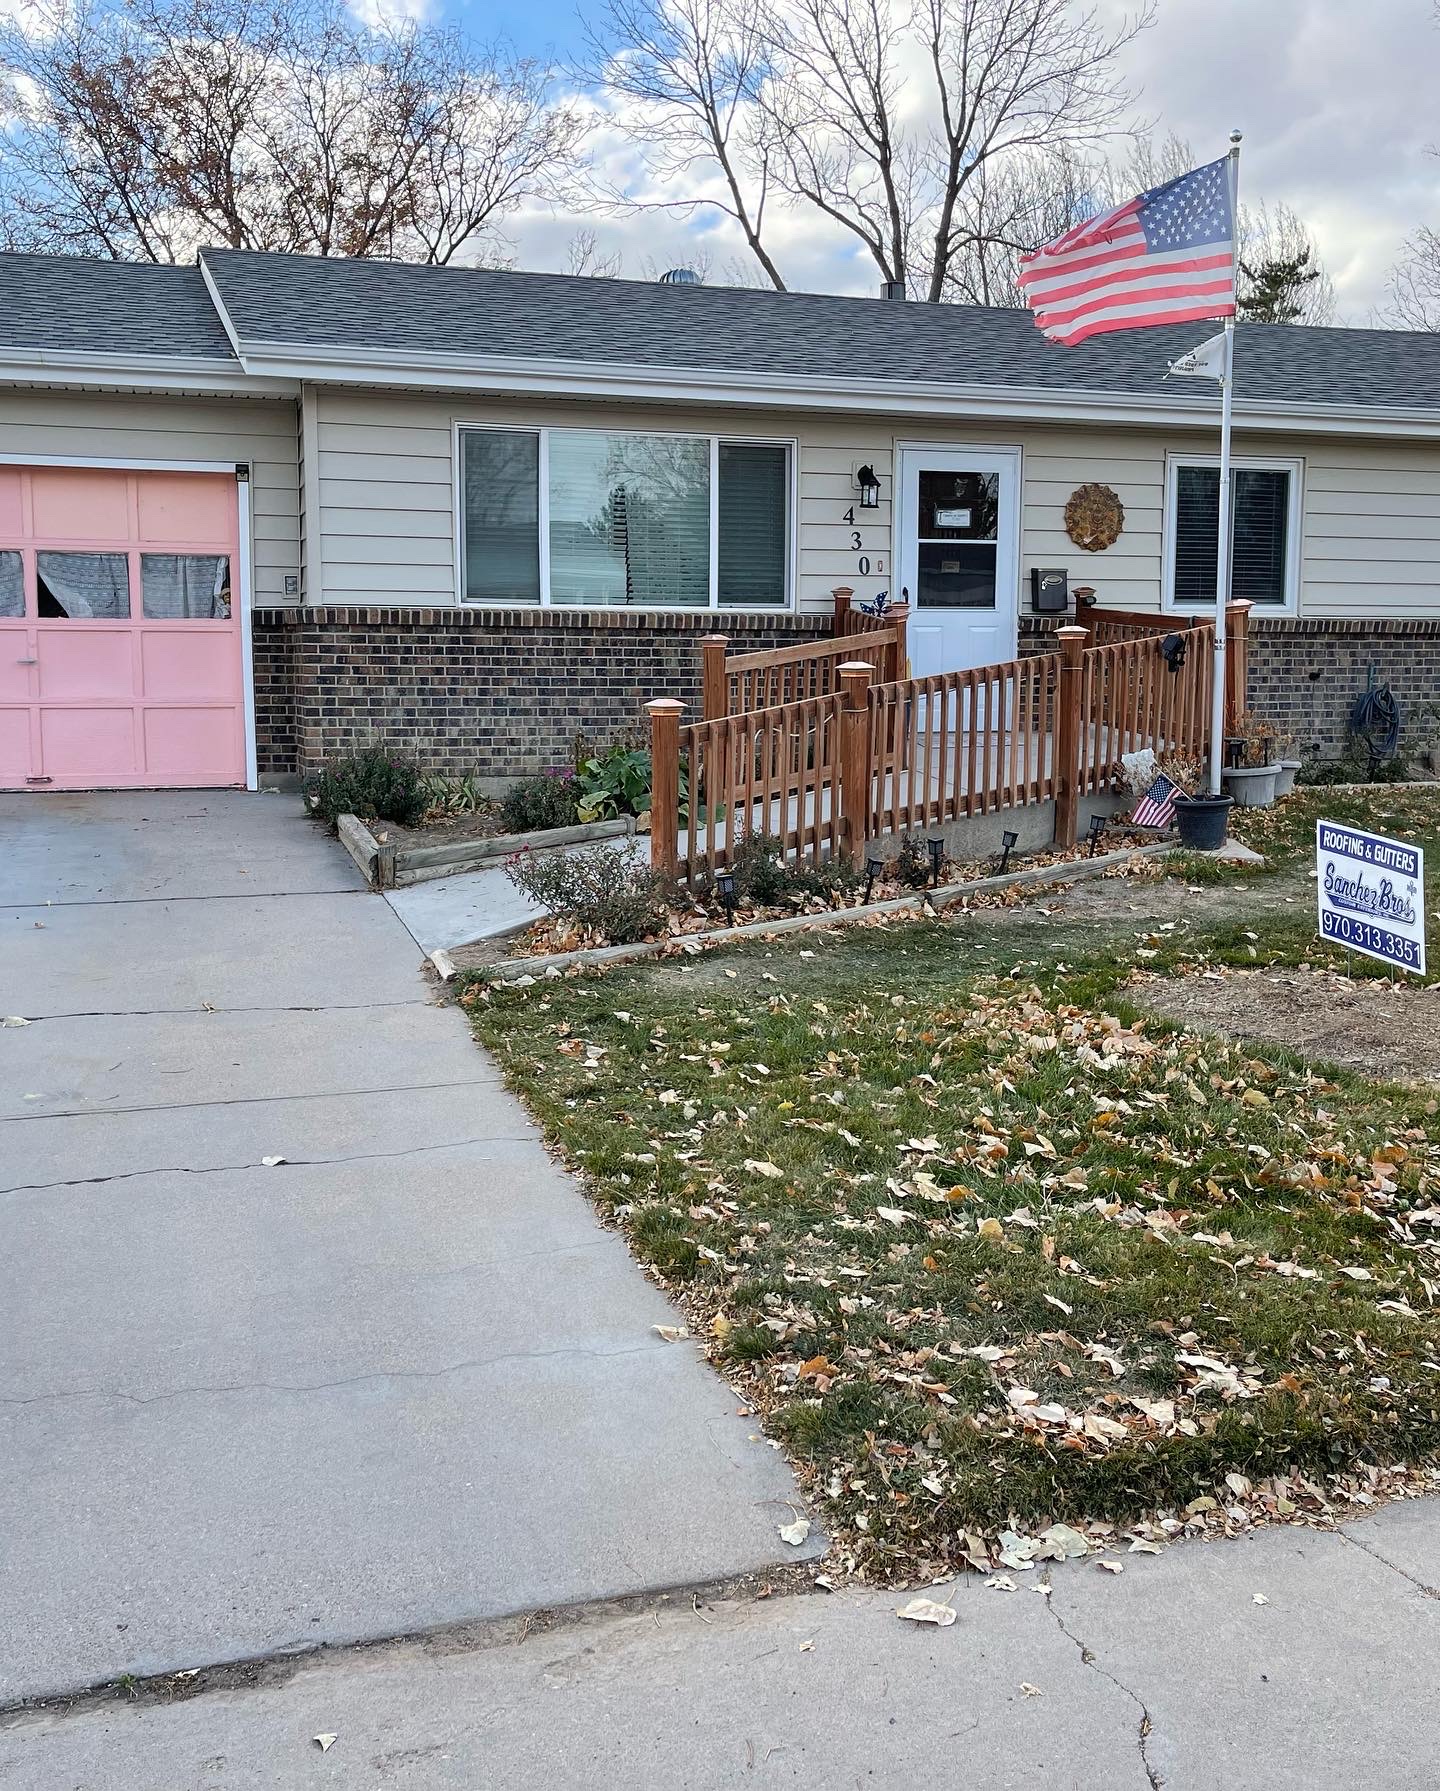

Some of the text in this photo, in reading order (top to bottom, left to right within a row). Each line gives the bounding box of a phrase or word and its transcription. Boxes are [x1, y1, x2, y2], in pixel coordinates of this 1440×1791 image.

[1323, 830, 1415, 873] ROOFING & GUTTERS
[1324, 861, 1377, 909] Sanchez
[1323, 912, 1421, 965] 970.313.3351
